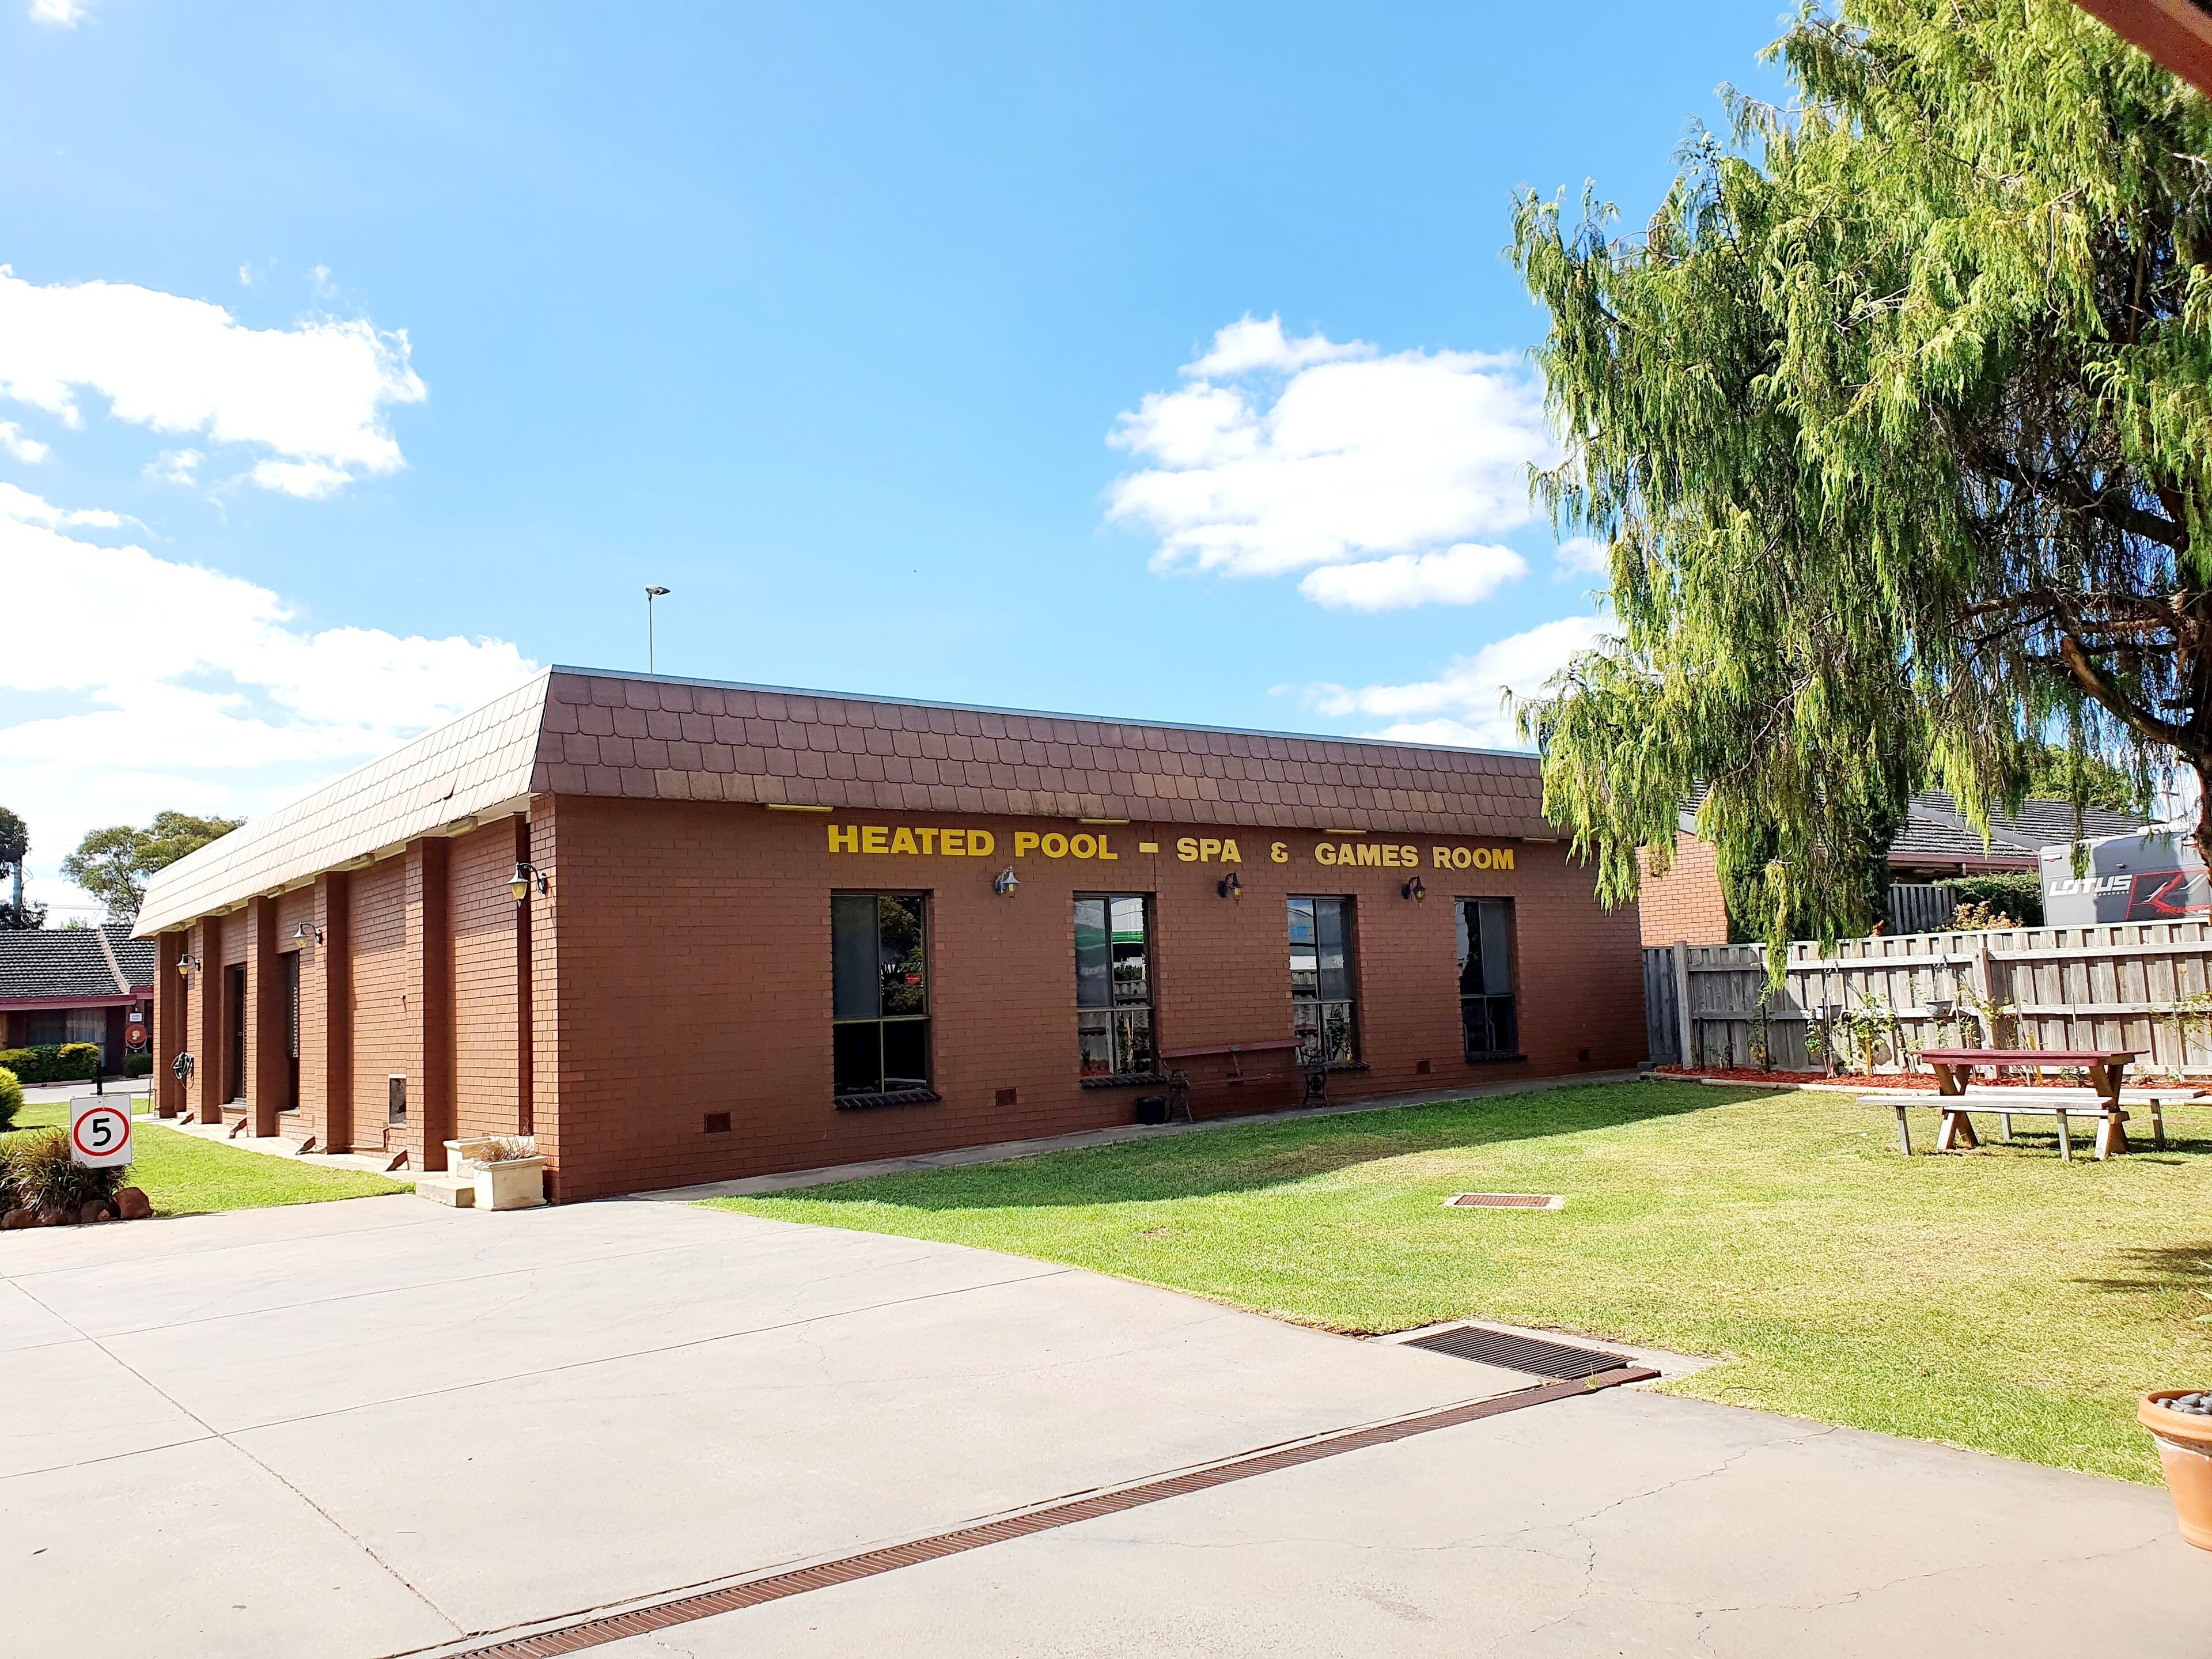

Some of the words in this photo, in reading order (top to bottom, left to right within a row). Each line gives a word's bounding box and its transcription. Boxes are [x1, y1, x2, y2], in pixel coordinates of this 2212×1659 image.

[827, 825, 995, 857] HEATED
[1014, 831, 1118, 860] POOL
[1176, 838, 1242, 862] SPA
[1271, 842, 1288, 863] &
[1315, 842, 1419, 868] GAMES
[1433, 847, 1514, 870] ROOM
[2048, 874, 2133, 896] LOTUS
[92, 1118, 111, 1147] 5
